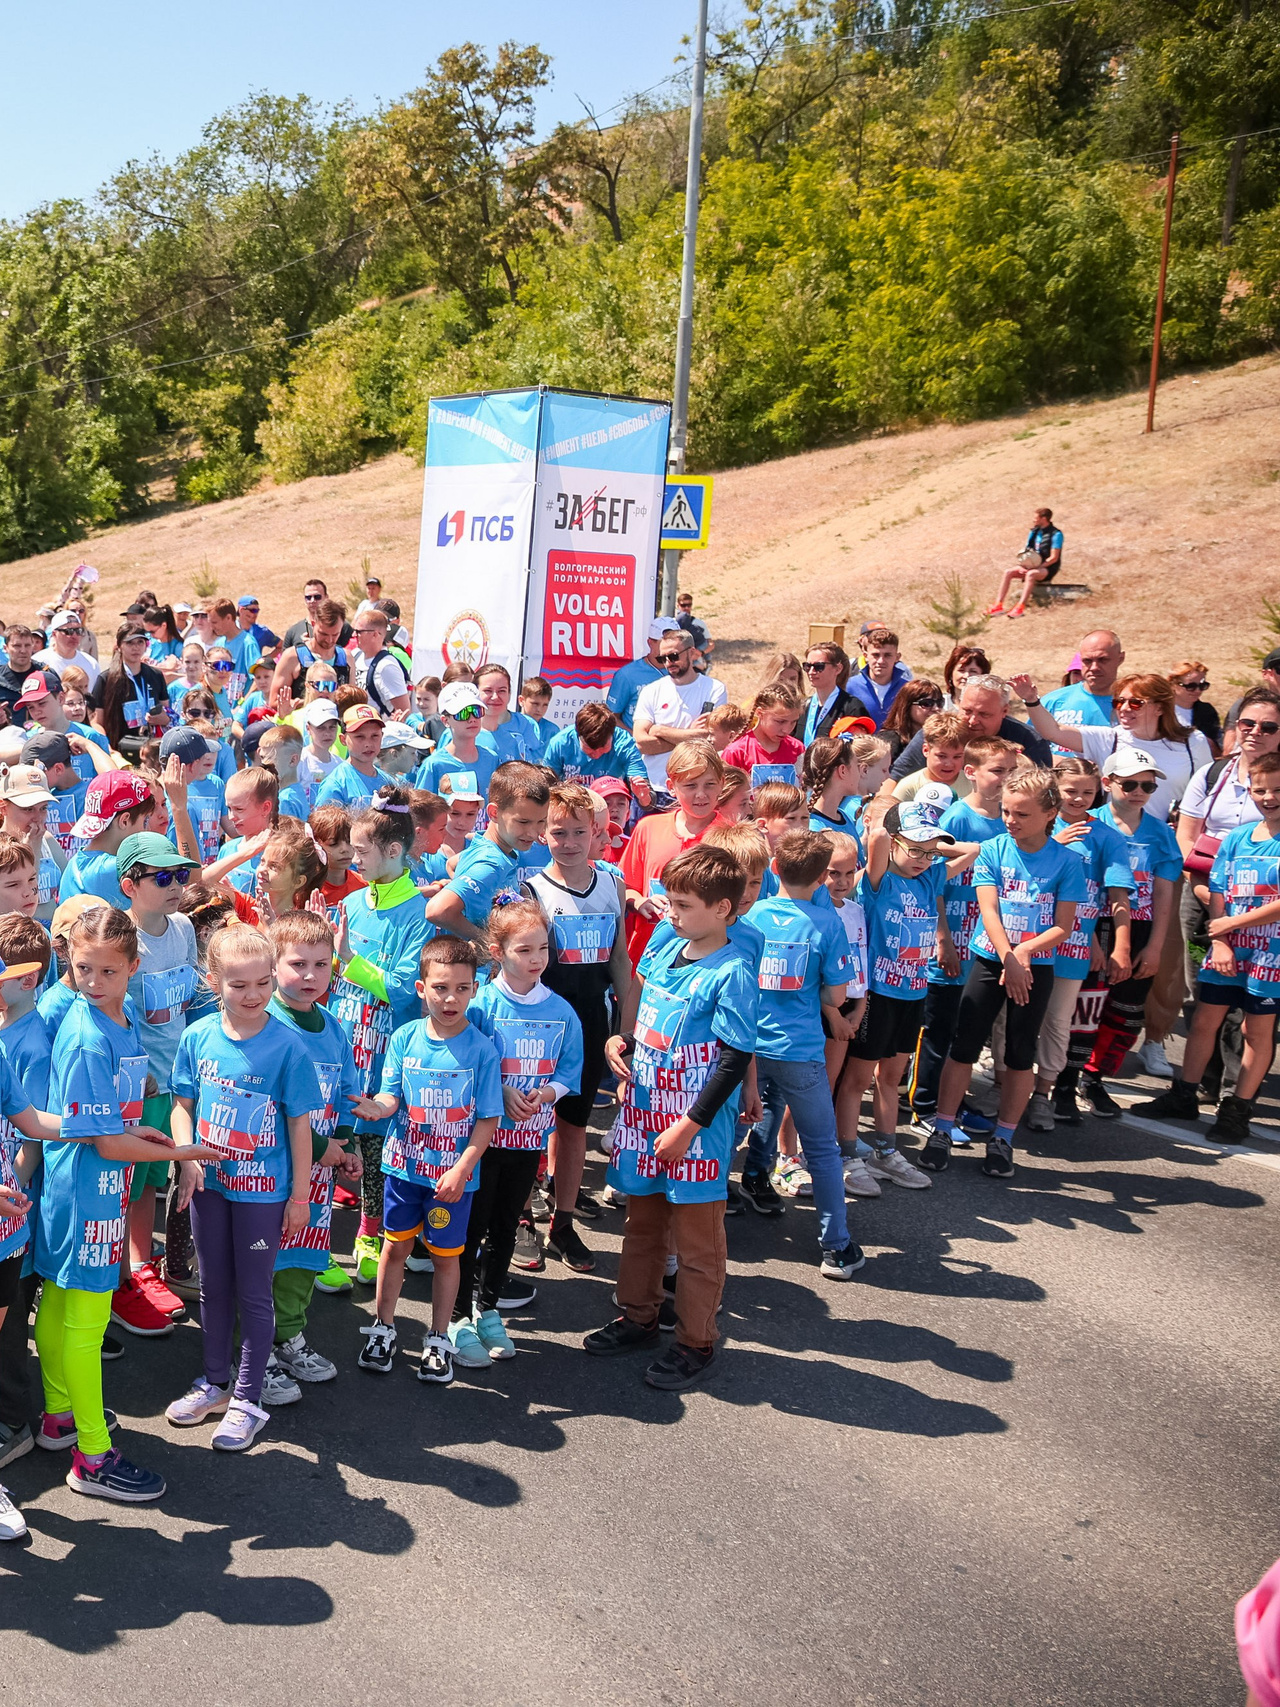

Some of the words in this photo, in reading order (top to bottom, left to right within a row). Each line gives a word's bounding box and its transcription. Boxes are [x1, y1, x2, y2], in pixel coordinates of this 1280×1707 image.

[581, 431, 608, 450] #ЦЕЛЬ
[609, 413, 650, 441] #СВОБОДА
[470, 515, 514, 542] ПСБ
[554, 563, 627, 576] ВОЛГОГРАДСКИЙ
[554, 574, 626, 587] ПОЛУМАРАФОН
[553, 593, 625, 618] VOLGA
[552, 621, 625, 658] RUN
[1236, 870, 1259, 884] 1130
[575, 930, 601, 948] 1180
[580, 948, 598, 963] 1КМ
[761, 975, 781, 989] 1КМ
[165, 983, 186, 1007] 1027
[514, 1038, 546, 1058] 1008
[519, 1059, 539, 1075] 1КМ
[419, 1087, 453, 1108] 1066
[82, 1103, 111, 1116] ПСБ
[210, 1102, 238, 1128] 1171
[424, 1108, 447, 1124] 1КМ
[208, 1124, 231, 1147] 1КМ
[236, 1160, 266, 1177] 2024
[215, 1169, 276, 1193] #ЕДИНСТВО
